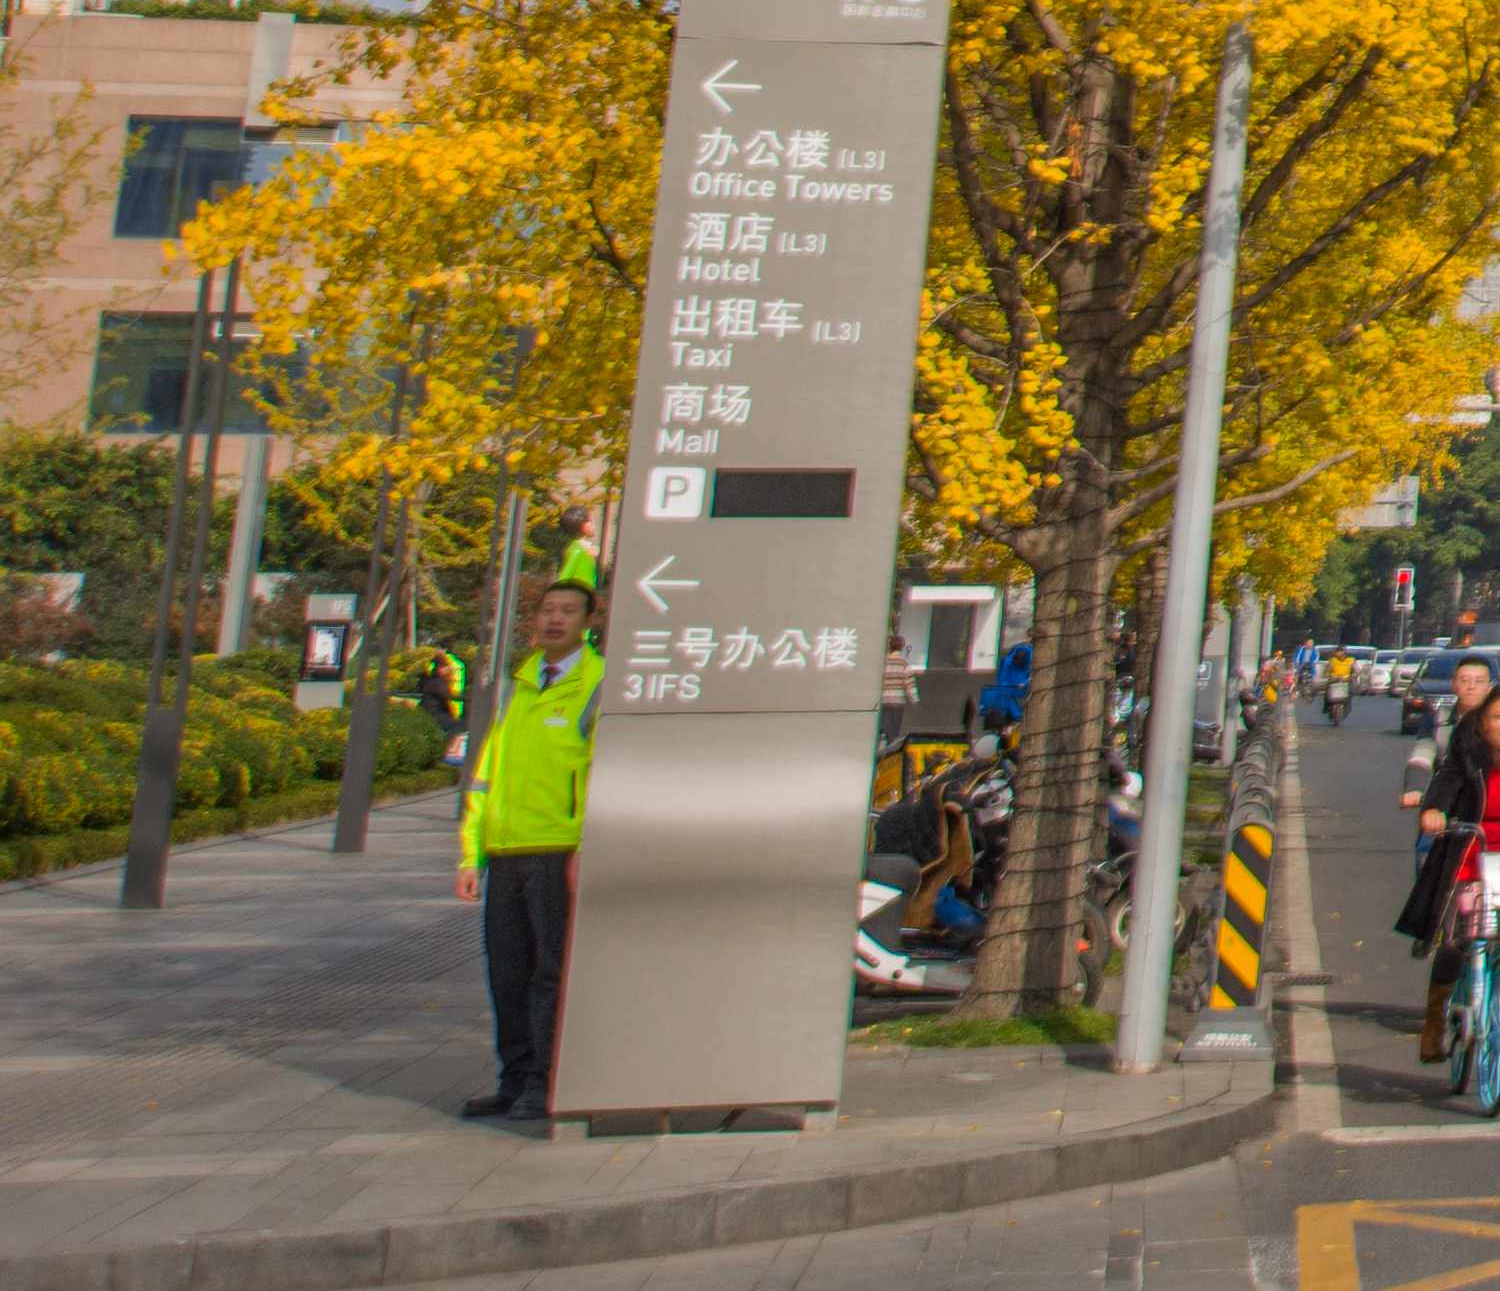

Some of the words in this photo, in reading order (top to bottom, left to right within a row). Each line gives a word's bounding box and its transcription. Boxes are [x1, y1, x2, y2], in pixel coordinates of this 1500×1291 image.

[695, 126, 831, 169] 办公楼
[690, 171, 777, 198] Office
[784, 175, 894, 202] Towers
[684, 212, 776, 252] 酒店
[680, 256, 761, 283] Hotel
[672, 295, 804, 338] 出租车
[671, 341, 734, 367] Taxi
[662, 382, 752, 423] 商场
[656, 427, 720, 455] Mall
[661, 475, 689, 510] P
[628, 626, 860, 669] 三号办公楼
